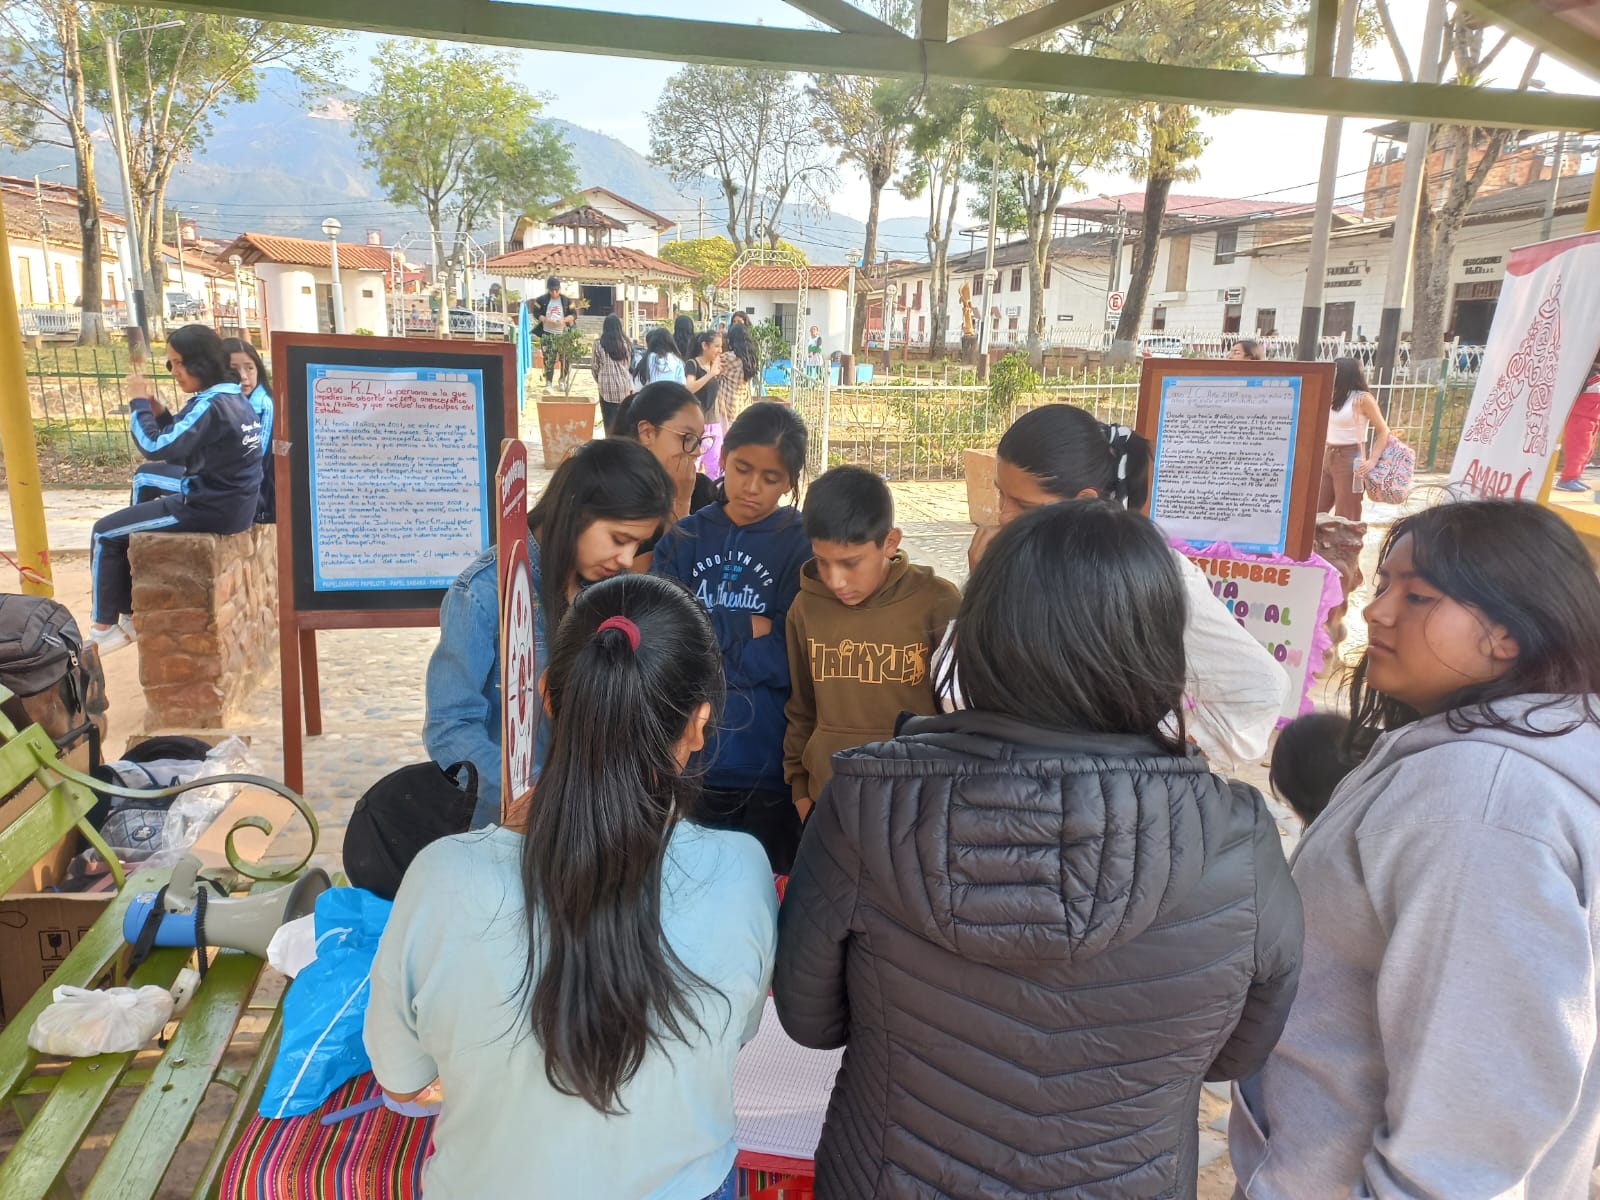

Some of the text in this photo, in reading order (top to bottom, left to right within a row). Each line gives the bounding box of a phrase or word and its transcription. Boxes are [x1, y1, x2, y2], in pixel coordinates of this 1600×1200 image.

[316, 378, 343, 394] Caso
[440, 388, 447, 396] la
[452, 391, 467, 399] que
[753, 562, 773, 586] NYC
